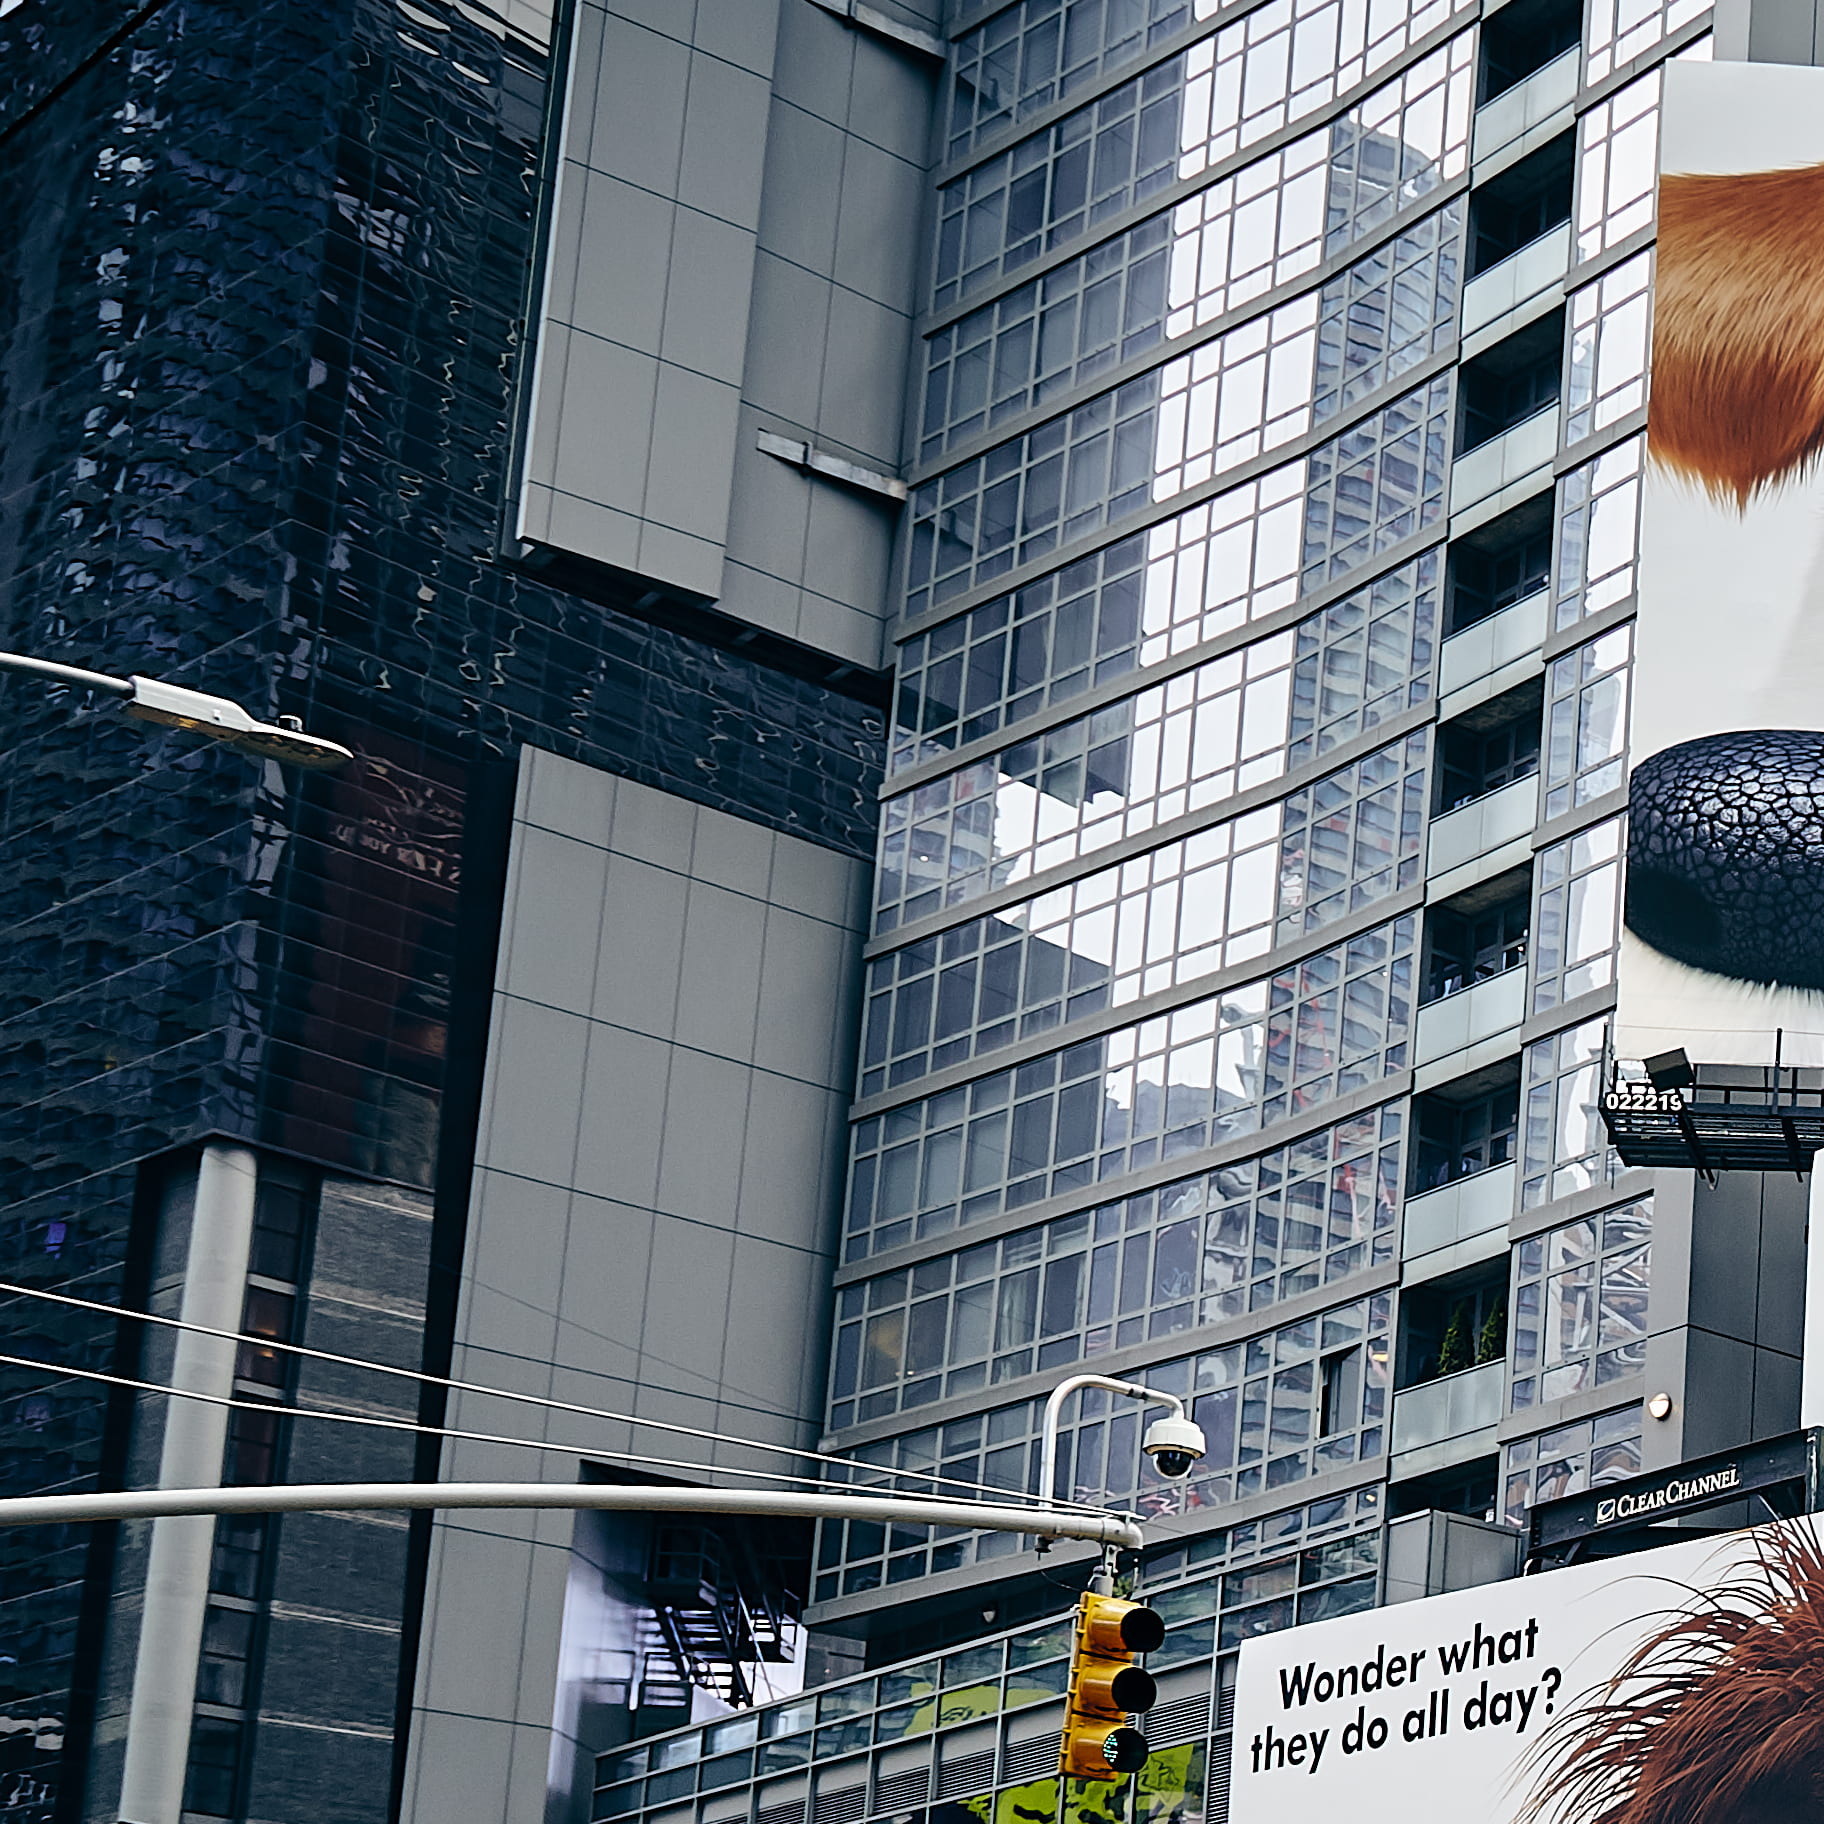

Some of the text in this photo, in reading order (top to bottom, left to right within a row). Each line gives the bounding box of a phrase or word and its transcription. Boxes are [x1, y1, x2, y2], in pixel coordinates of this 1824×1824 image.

[1617, 1467, 1741, 1519] CLEARCHANNEL
[1279, 1617, 1539, 1711] Wonder what
[1250, 1666, 1563, 1775] they do all day?
